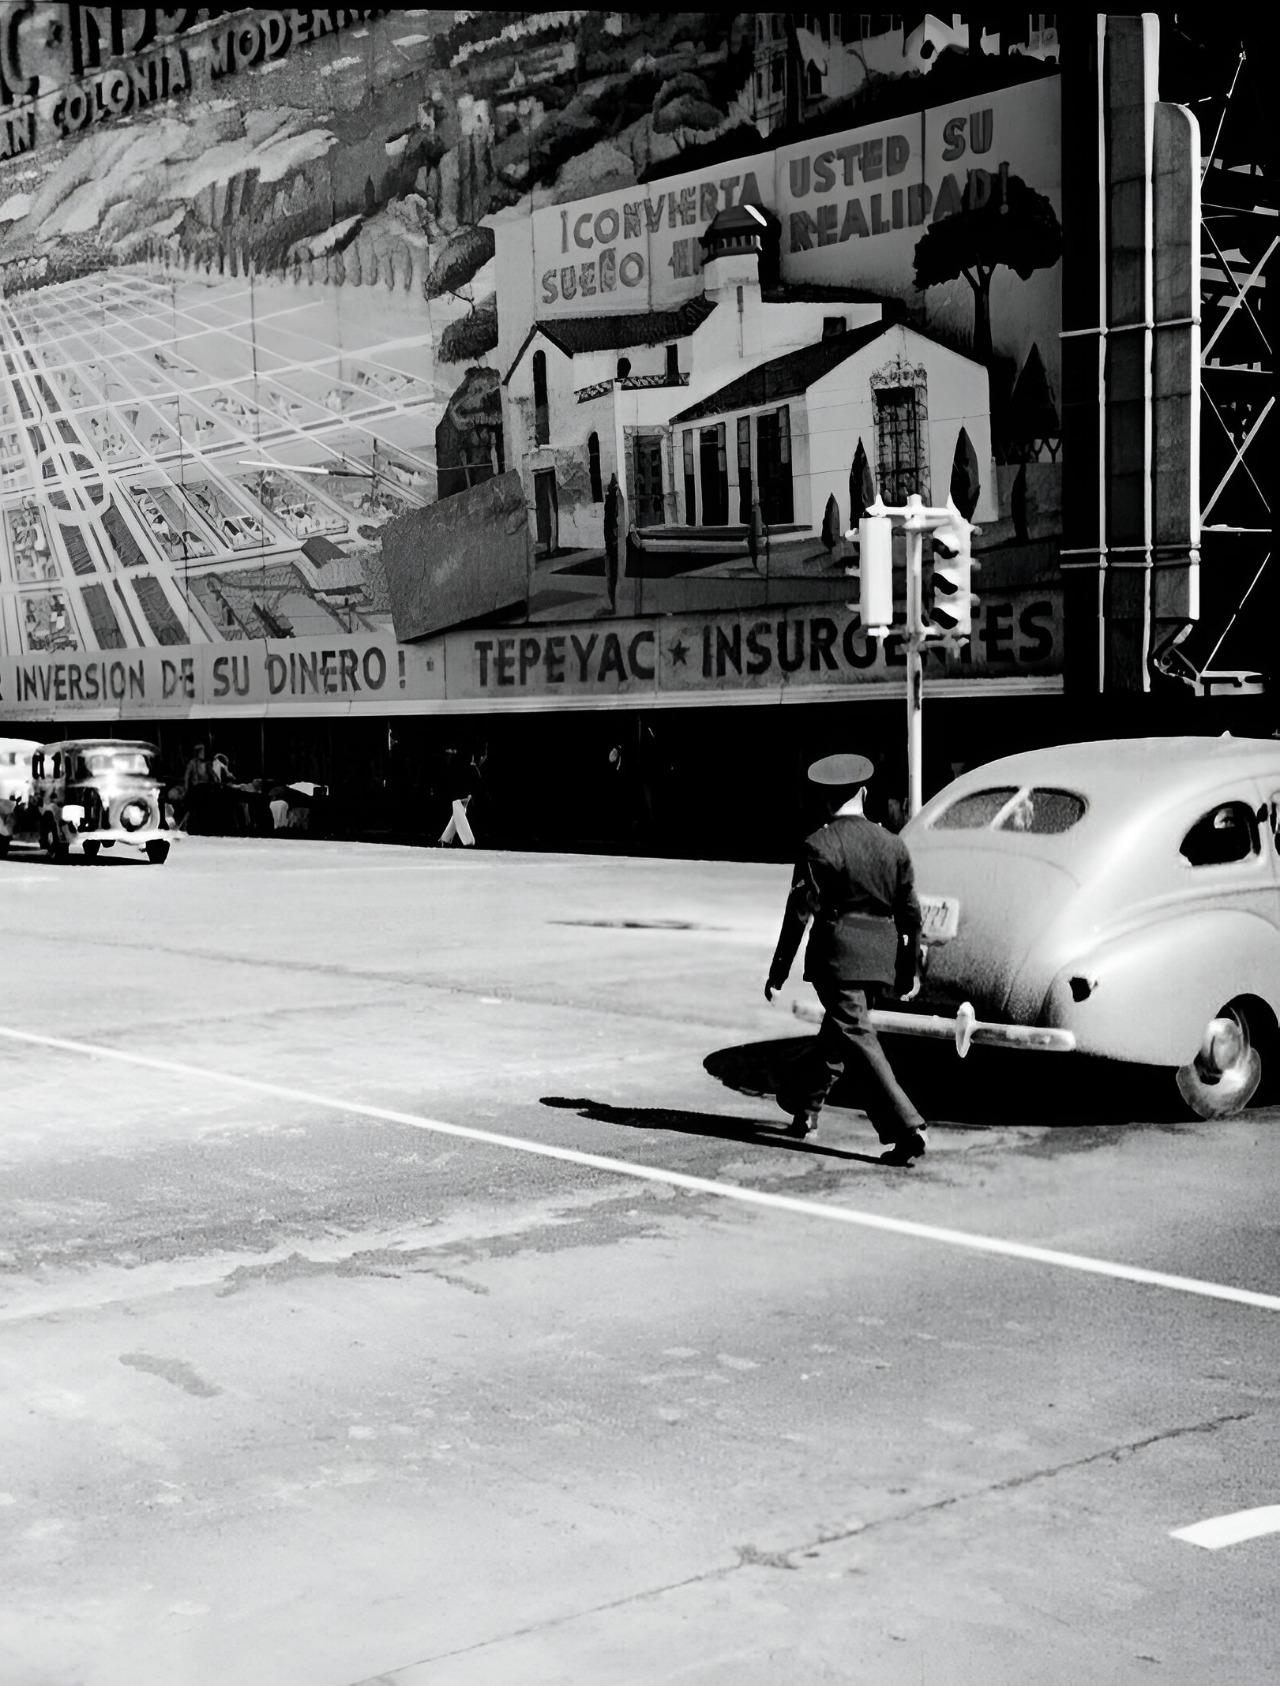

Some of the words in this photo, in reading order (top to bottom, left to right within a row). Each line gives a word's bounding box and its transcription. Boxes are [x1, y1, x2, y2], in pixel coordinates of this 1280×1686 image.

[52, 48, 192, 138] COLONIA
[789, 135, 910, 198] USTED
[942, 108, 993, 161] SU
[790, 161, 1009, 253] REALIDAD!
[16, 659, 145, 703] INVERSION
[162, 657, 195, 699] DE
[213, 653, 250, 697] SU
[474, 631, 655, 687] TEPEYAC
